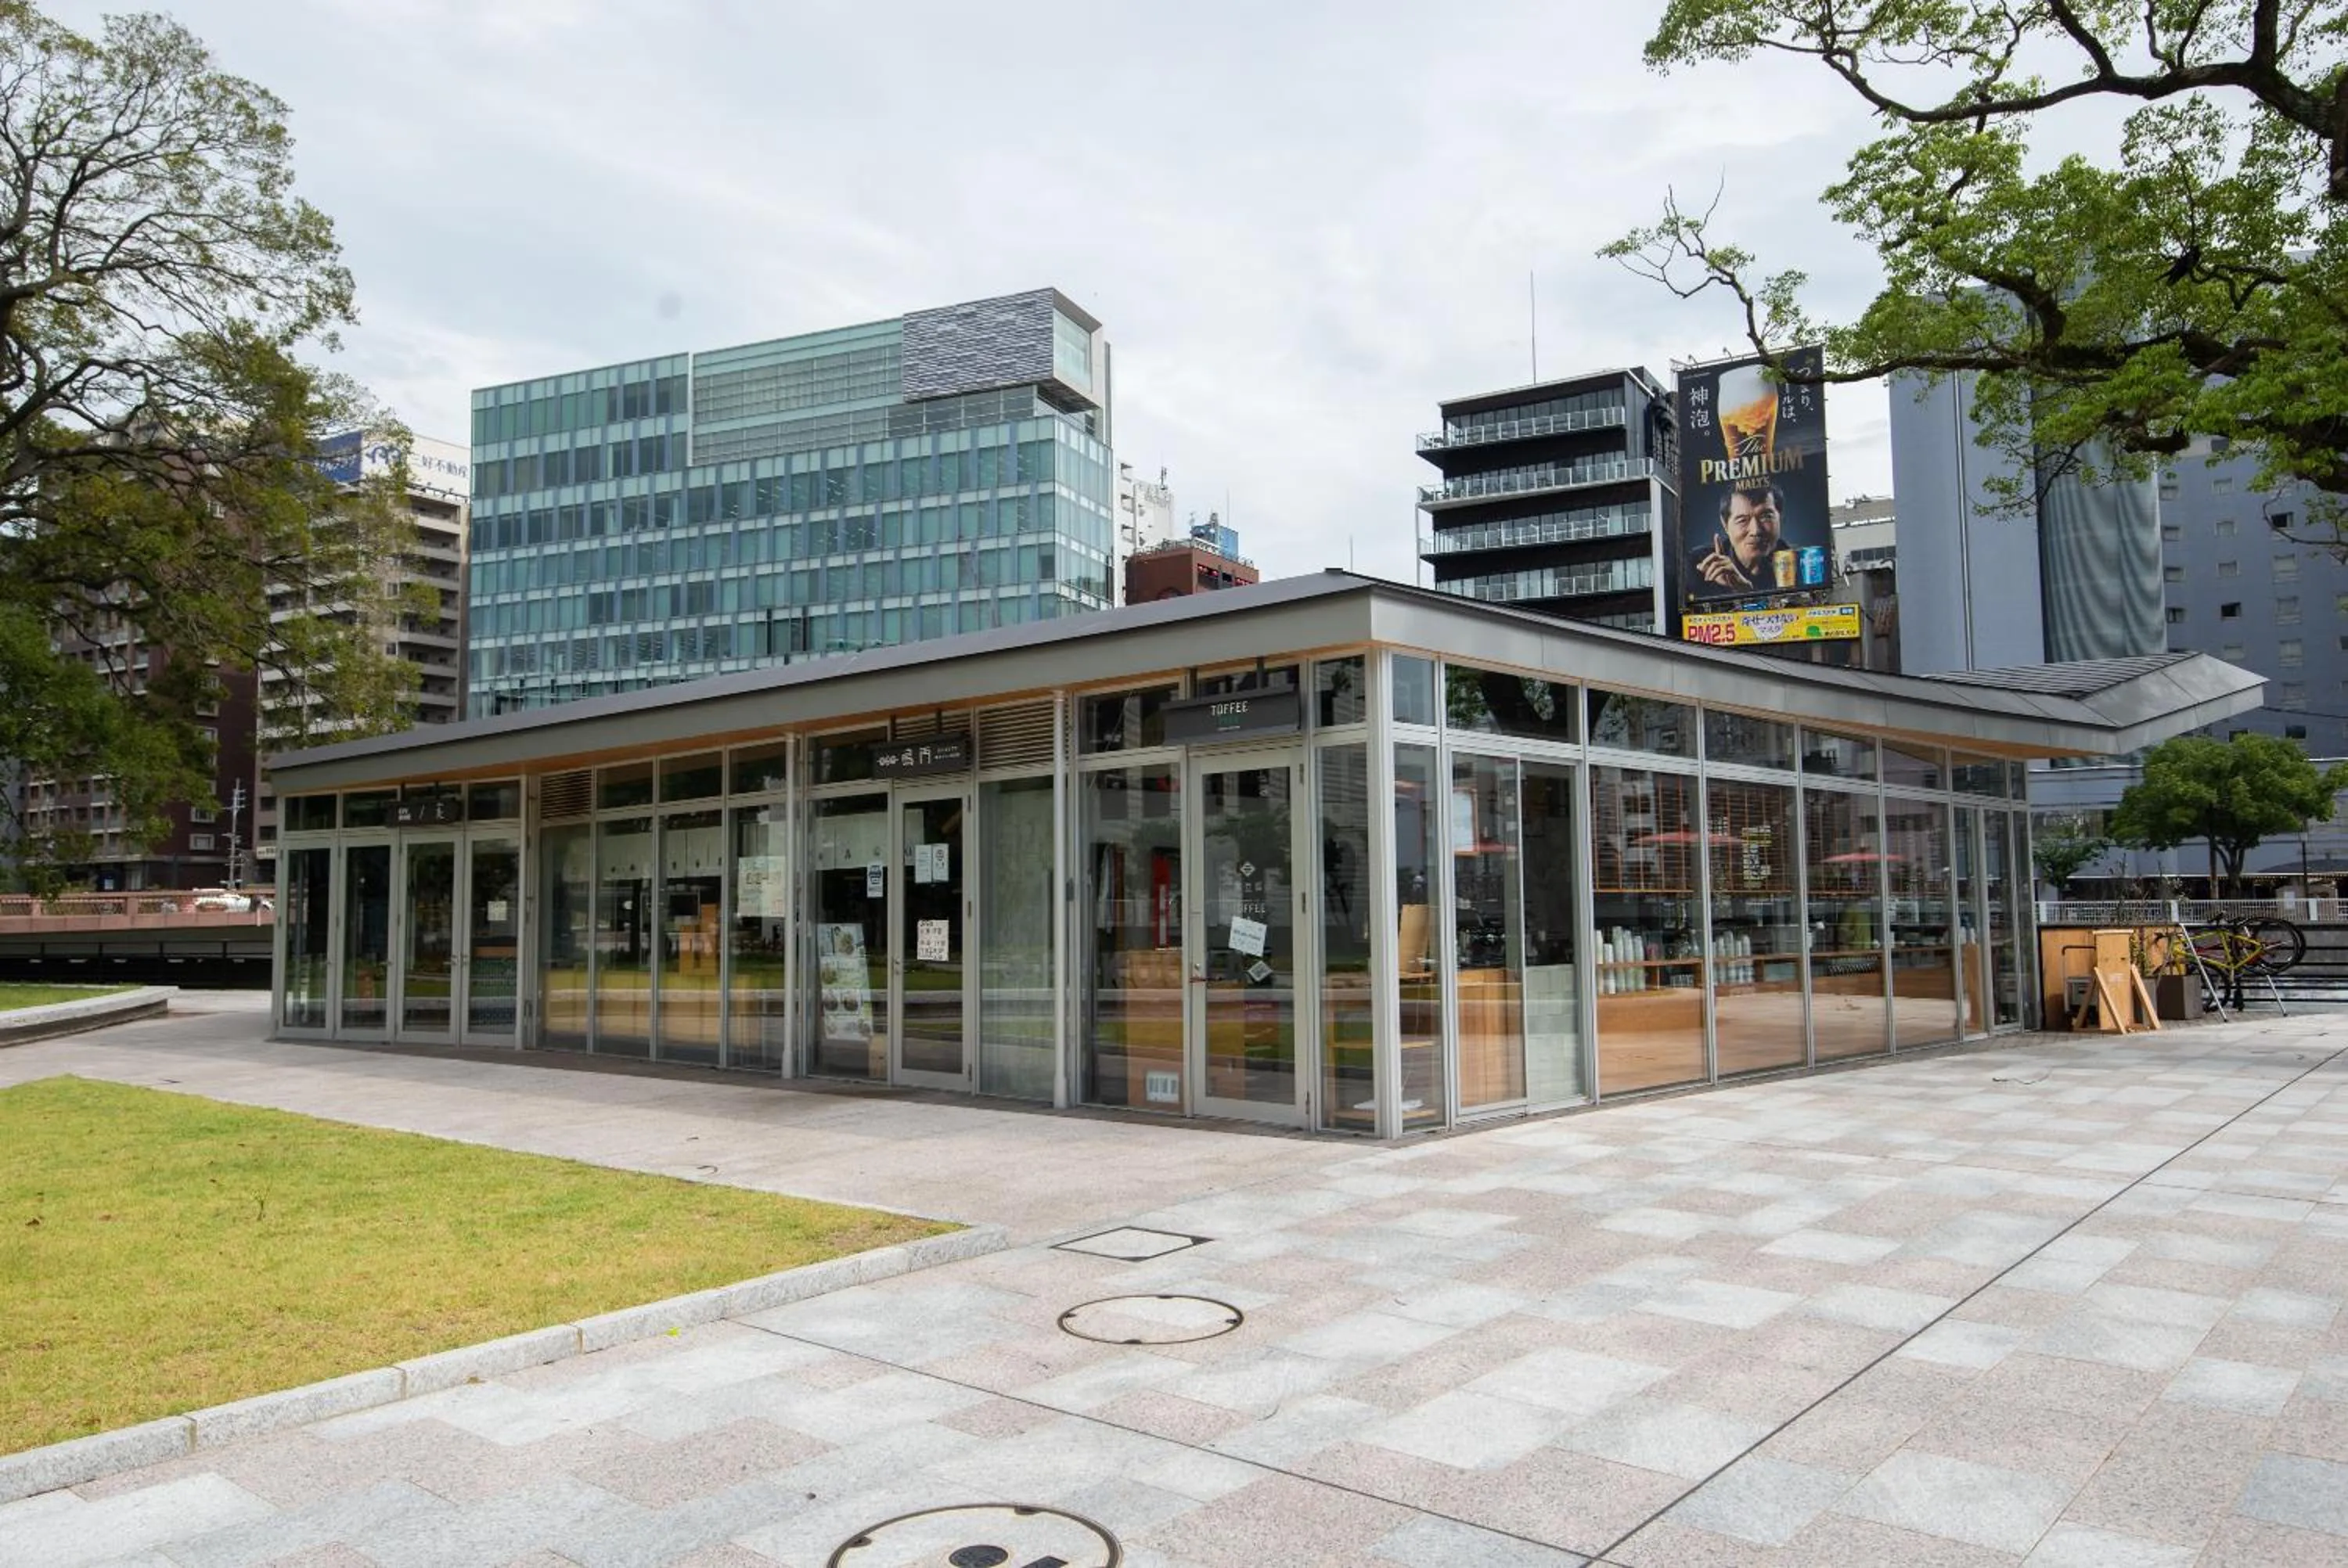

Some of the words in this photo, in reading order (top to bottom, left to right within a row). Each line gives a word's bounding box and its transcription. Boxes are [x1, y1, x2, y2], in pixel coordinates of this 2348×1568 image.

[1734, 434, 1766, 456] The
[1700, 445, 1805, 484] PREMIUM
[1687, 623, 1735, 643] PM2.5
[1211, 701, 1248, 716] TOFFEE
